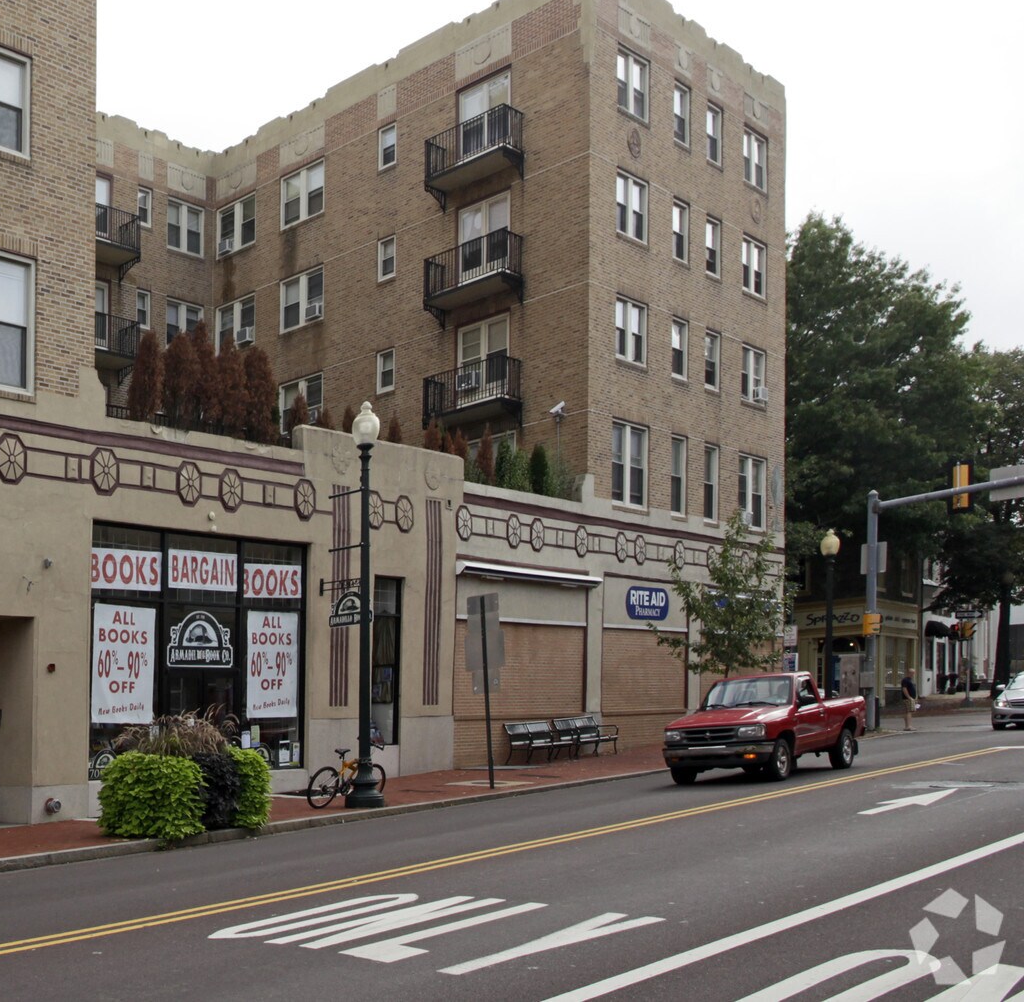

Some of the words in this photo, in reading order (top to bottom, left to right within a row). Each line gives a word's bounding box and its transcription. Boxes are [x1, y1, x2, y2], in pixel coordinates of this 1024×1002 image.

[91, 553, 159, 586] BOOKS
[171, 554, 235, 586] BARGAIN
[630, 590, 650, 606] RITE
[650, 591, 666, 607] AID
[112, 611, 135, 626] ALL
[262, 616, 282, 629] ALL
[98, 628, 148, 645] BOOKS
[251, 632, 292, 646] BOOKS
[109, 680, 135, 694] OFF
[261, 678, 283, 691] OFF
[129, 701, 145, 712] Daily
[207, 893, 666, 975] ONLY
